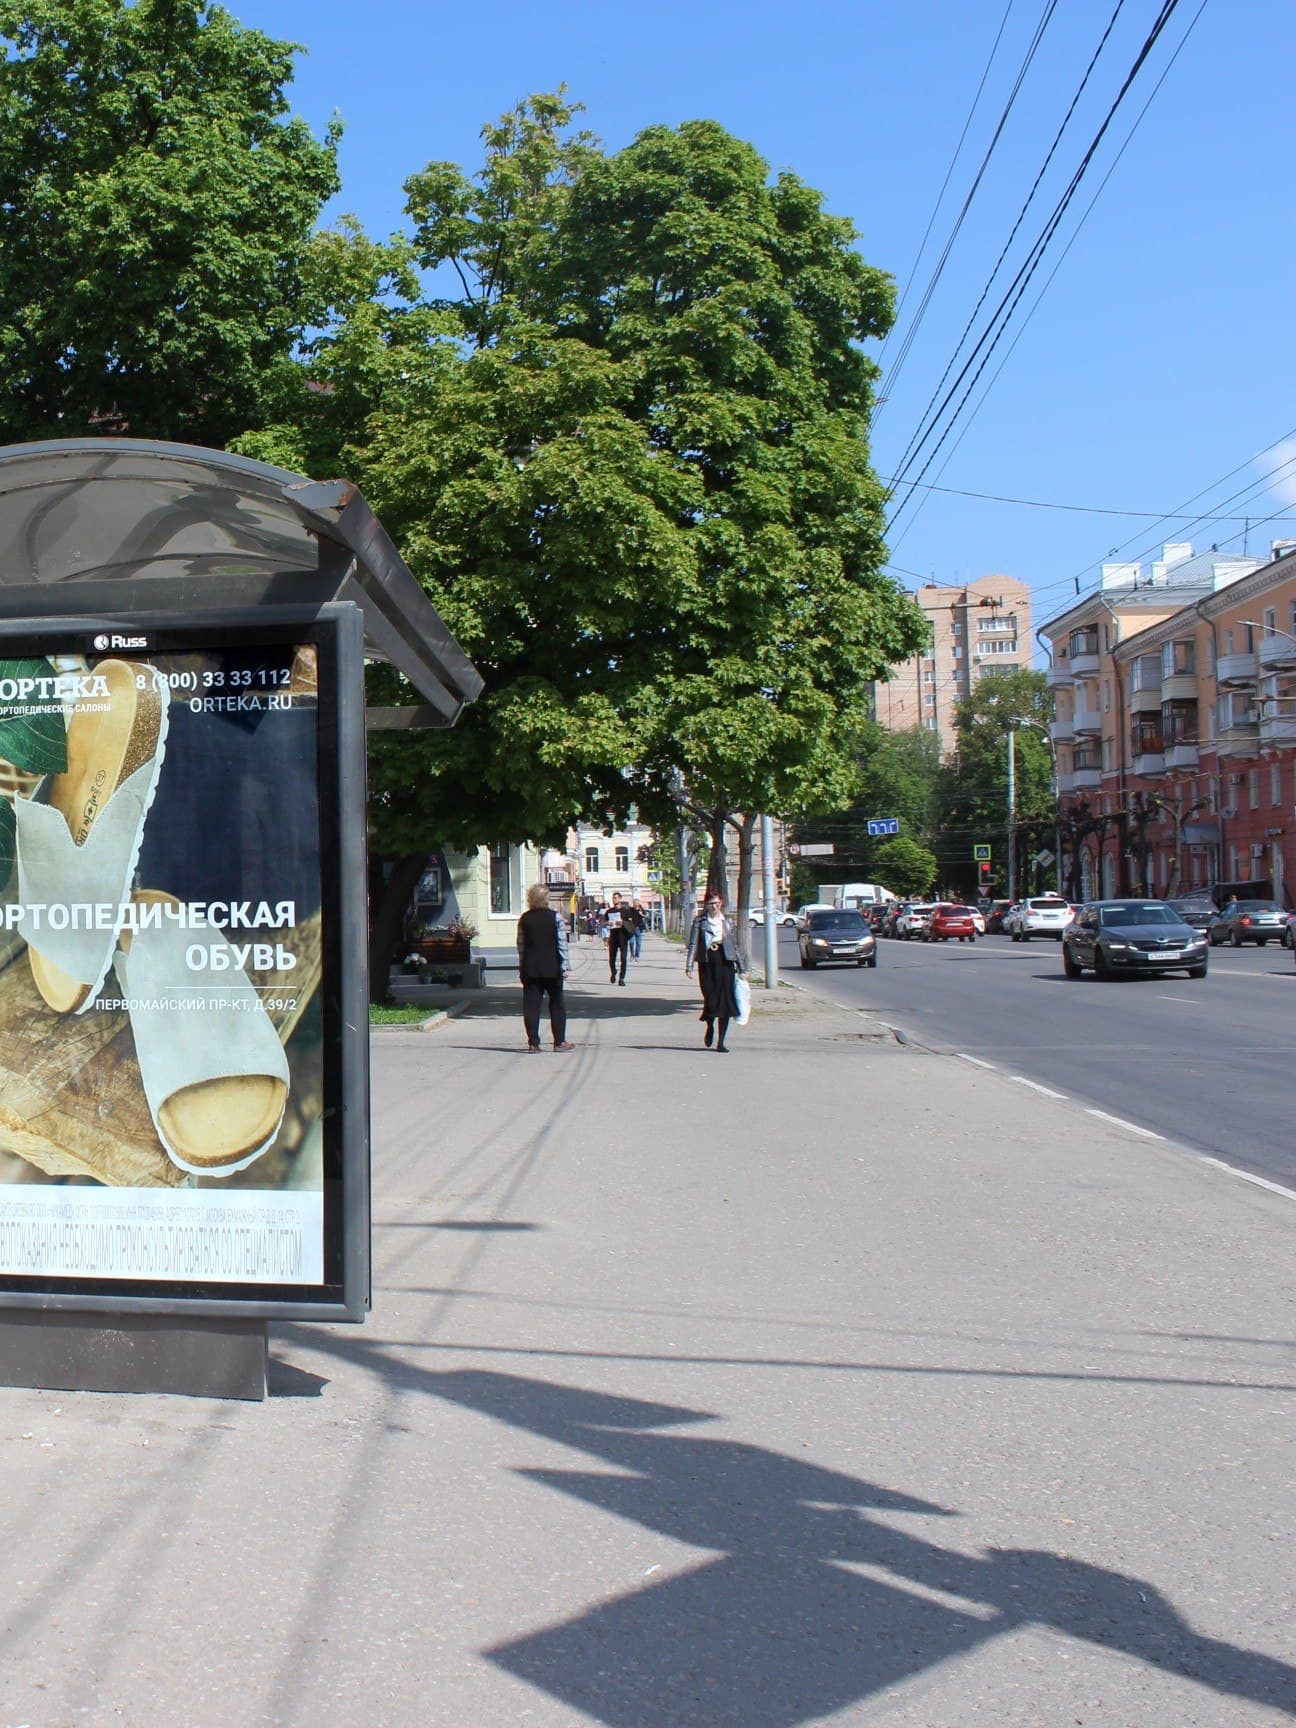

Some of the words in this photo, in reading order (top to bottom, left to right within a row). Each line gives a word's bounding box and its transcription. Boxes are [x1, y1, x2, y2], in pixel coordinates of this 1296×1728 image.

[111, 635, 147, 648] Russ
[136, 674, 146, 690] 8
[152, 672, 197, 693] (800)
[202, 671, 225, 687] 33
[230, 670, 252, 686] 33
[258, 669, 291, 685] 112
[75, 703, 111, 713] САЛОНЫ
[190, 695, 292, 713] ORTEKA.RU
[185, 943, 297, 971] ОБУВЬ
[95, 997, 206, 1012] ПЕРВОМАЙСКИЙ
[209, 999, 252, 1012] ПР-КТ,
[254, 998, 297, 1013] Д.39/2
